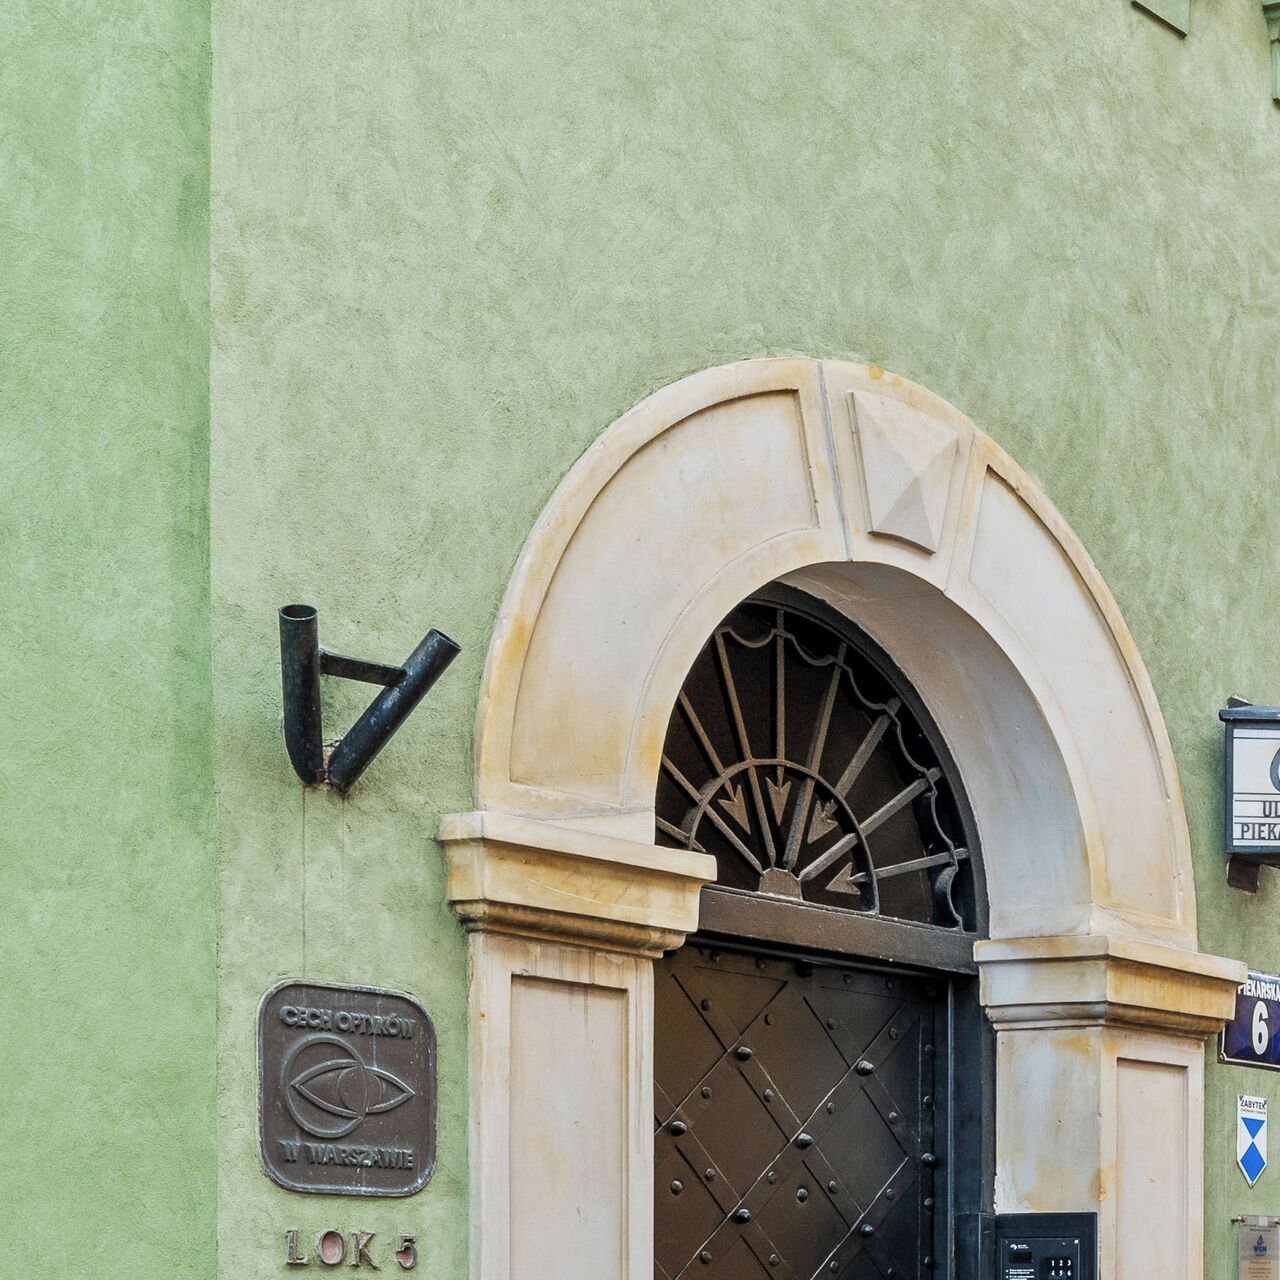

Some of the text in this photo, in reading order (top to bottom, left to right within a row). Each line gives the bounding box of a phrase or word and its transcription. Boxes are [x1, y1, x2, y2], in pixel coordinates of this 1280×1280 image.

[280, 1006, 332, 1031] CECH
[1252, 1001, 1269, 1055] 6
[303, 1143, 414, 1169] WARSZAWIE
[286, 1229, 417, 1271] LOK 5
